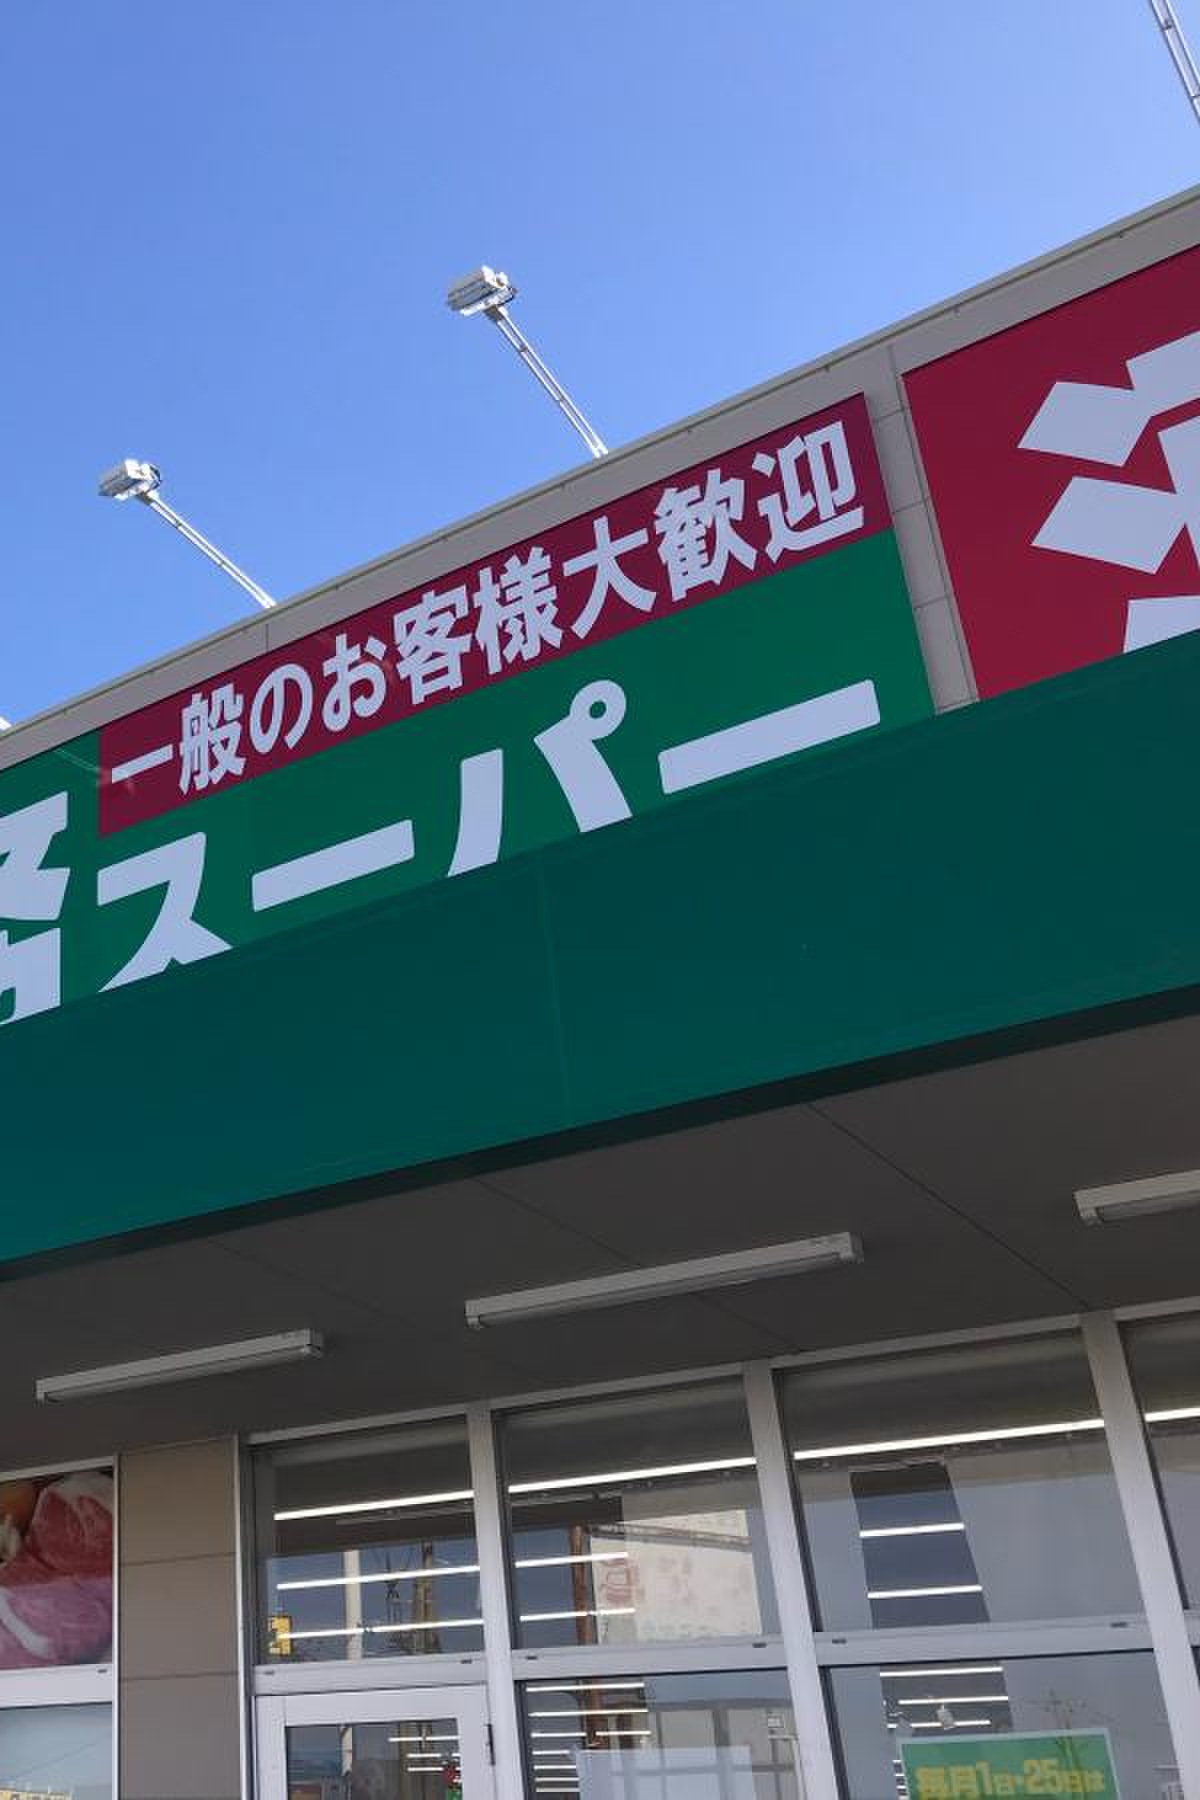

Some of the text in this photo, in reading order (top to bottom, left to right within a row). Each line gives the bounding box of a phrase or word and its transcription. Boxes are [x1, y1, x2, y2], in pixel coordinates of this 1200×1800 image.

[112, 421, 864, 794] 一般のお客様大歓迎
